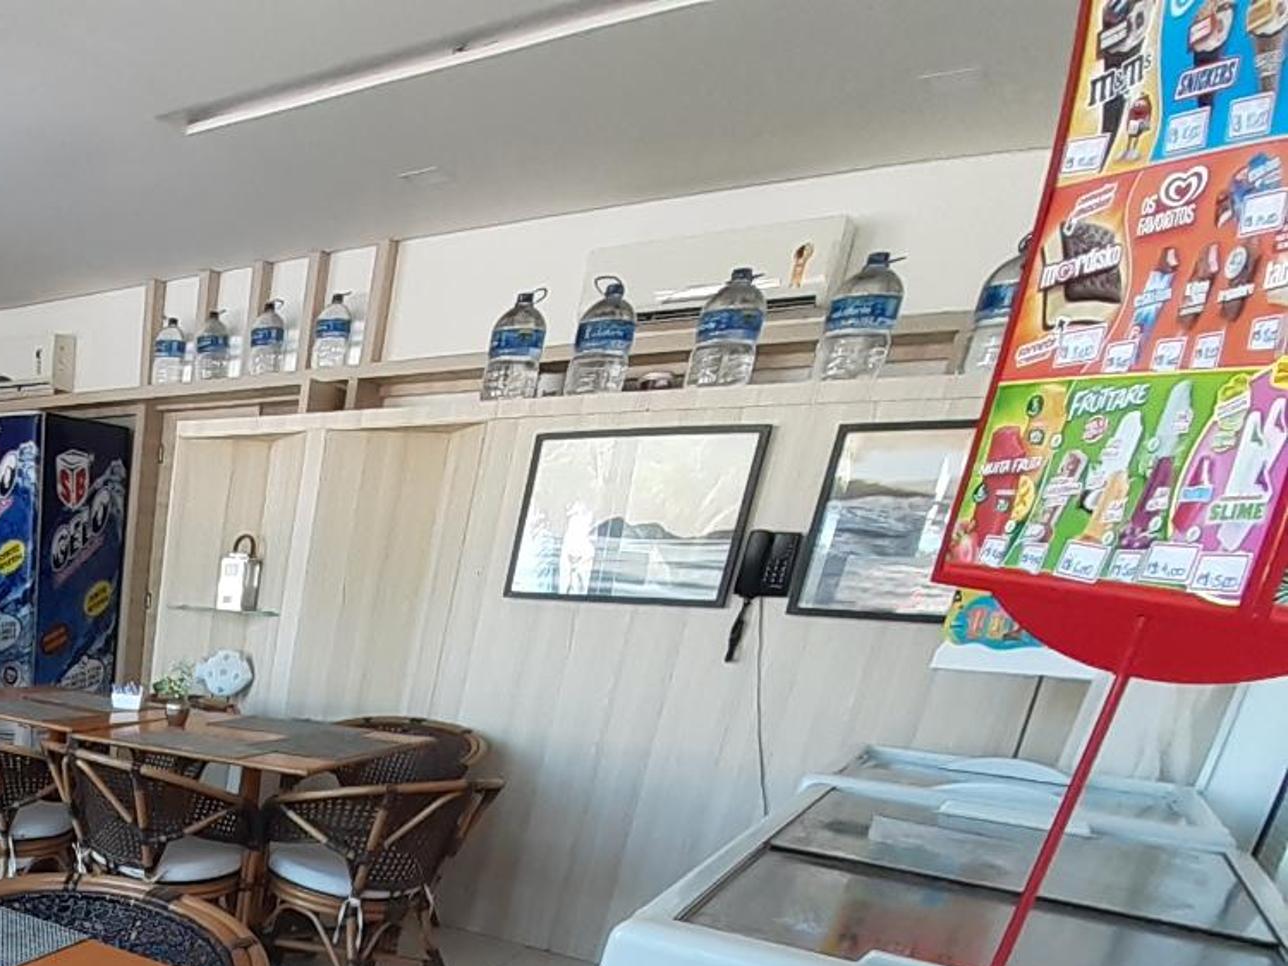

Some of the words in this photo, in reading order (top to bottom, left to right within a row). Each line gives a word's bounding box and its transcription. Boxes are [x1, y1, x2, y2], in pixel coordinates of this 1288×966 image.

[1177, 60, 1237, 96] SNICKERS
[1141, 195, 1158, 215] OS
[1137, 204, 1197, 235] FAVORITOS
[1208, 502, 1264, 521] SLIME
